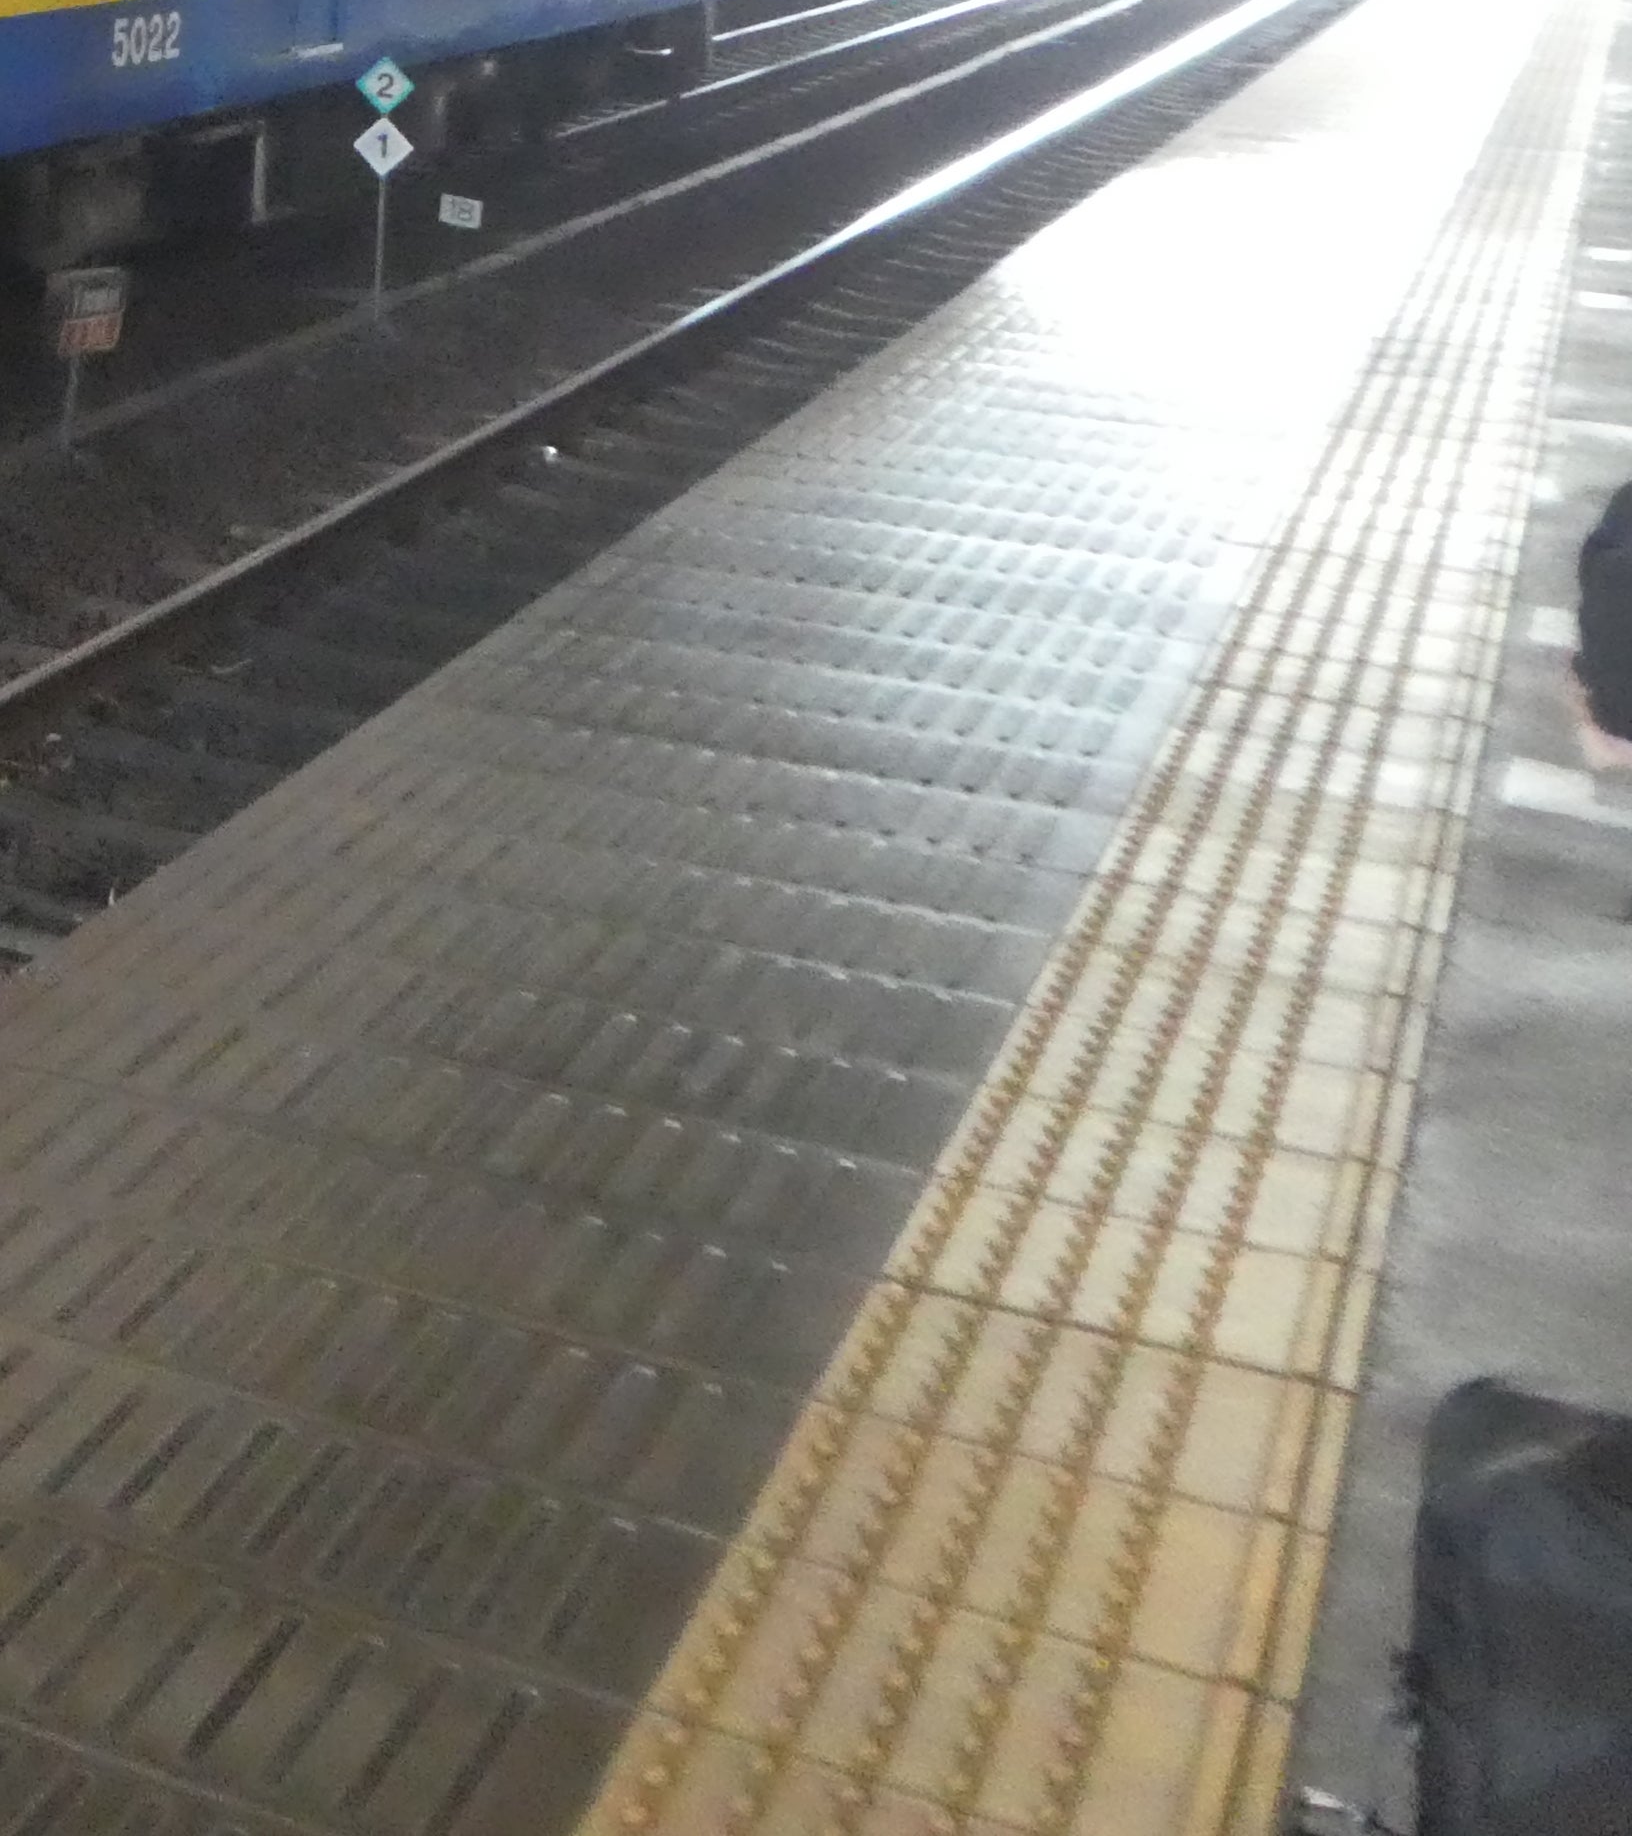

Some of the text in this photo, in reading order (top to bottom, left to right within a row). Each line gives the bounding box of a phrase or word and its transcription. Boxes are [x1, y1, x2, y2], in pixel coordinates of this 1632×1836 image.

[111, 11, 181, 67] 5022
[376, 72, 394, 98] 2
[376, 132, 388, 159] 1
